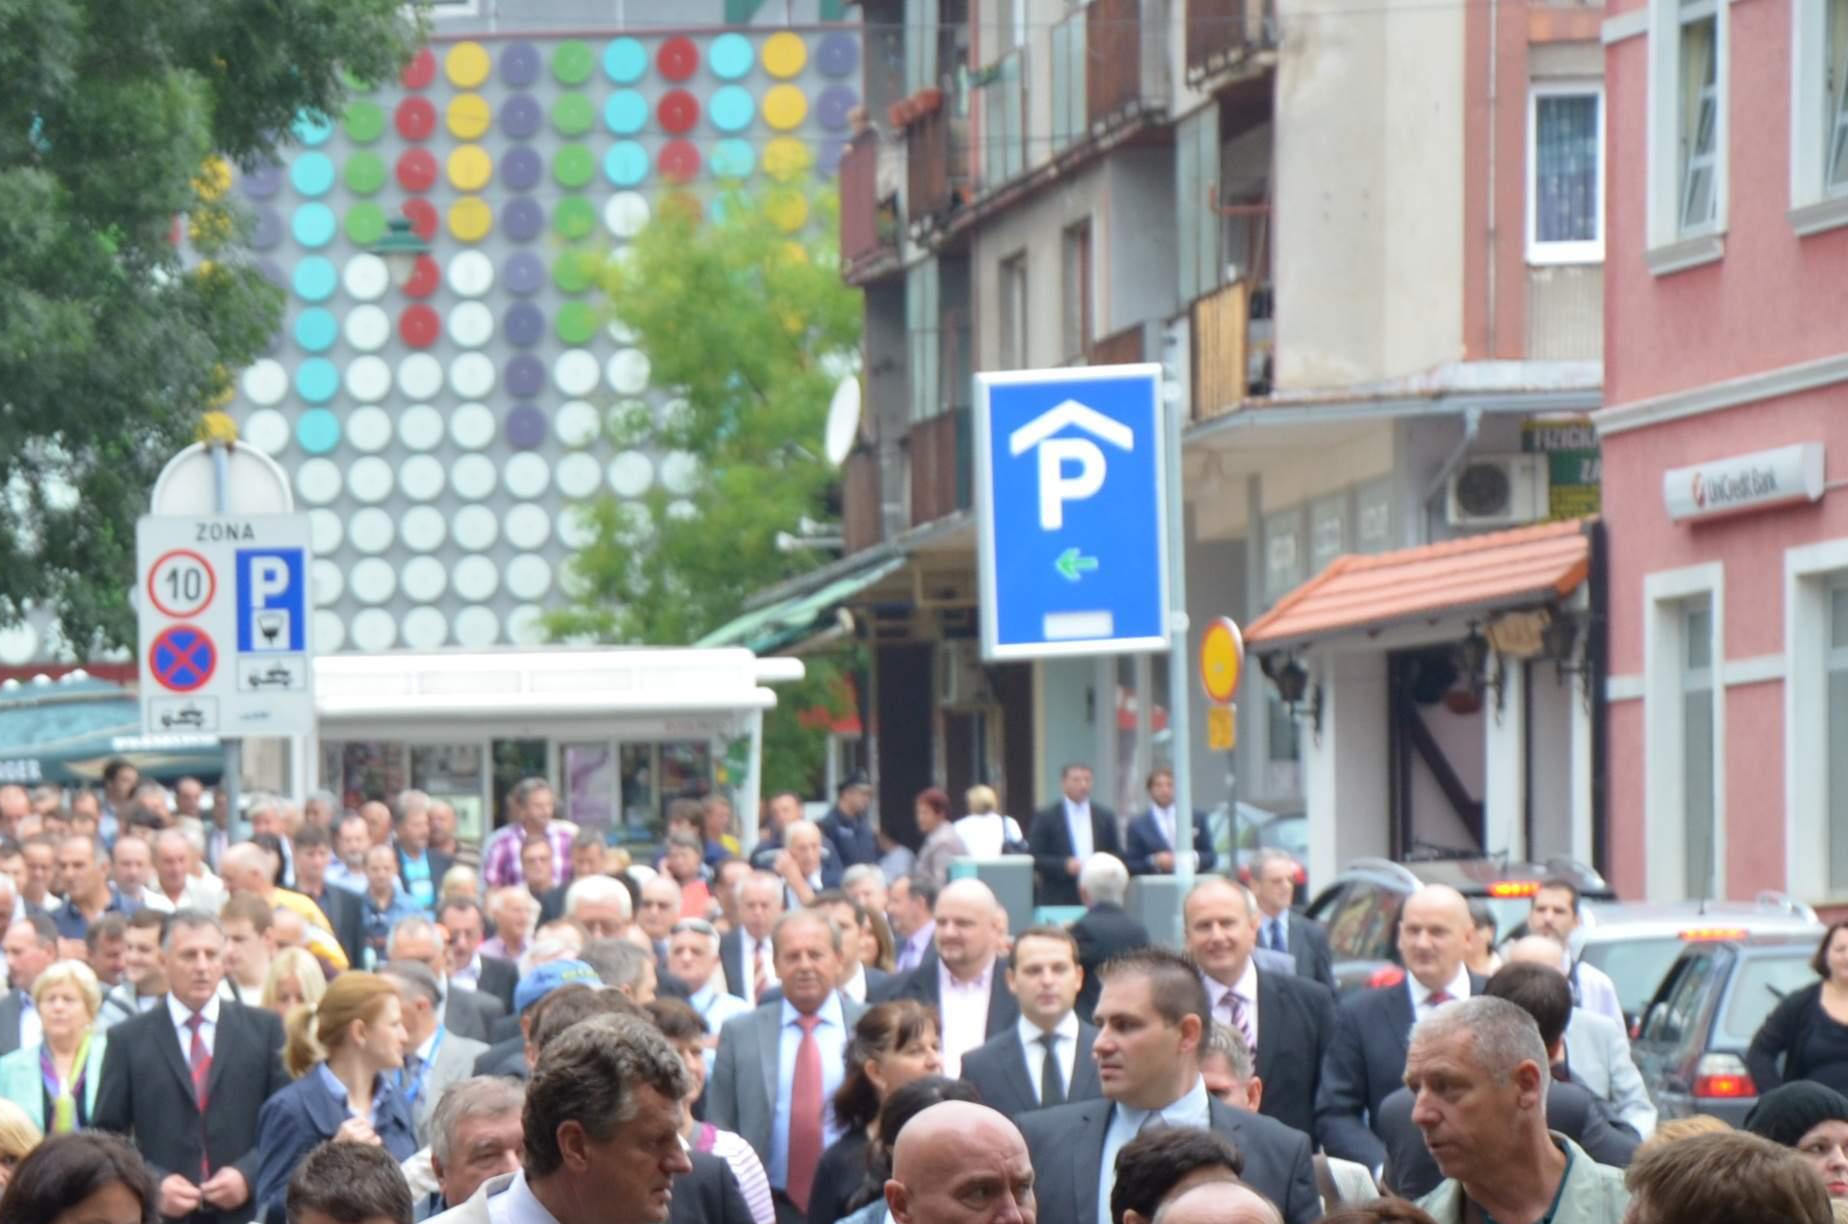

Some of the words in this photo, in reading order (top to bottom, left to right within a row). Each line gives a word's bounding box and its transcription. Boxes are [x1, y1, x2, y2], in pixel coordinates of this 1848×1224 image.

[1038, 437, 1107, 531] P
[1752, 464, 1777, 497] Bank
[195, 523, 255, 541] ZONA
[165, 567, 201, 601] 10
[250, 556, 290, 608] P
